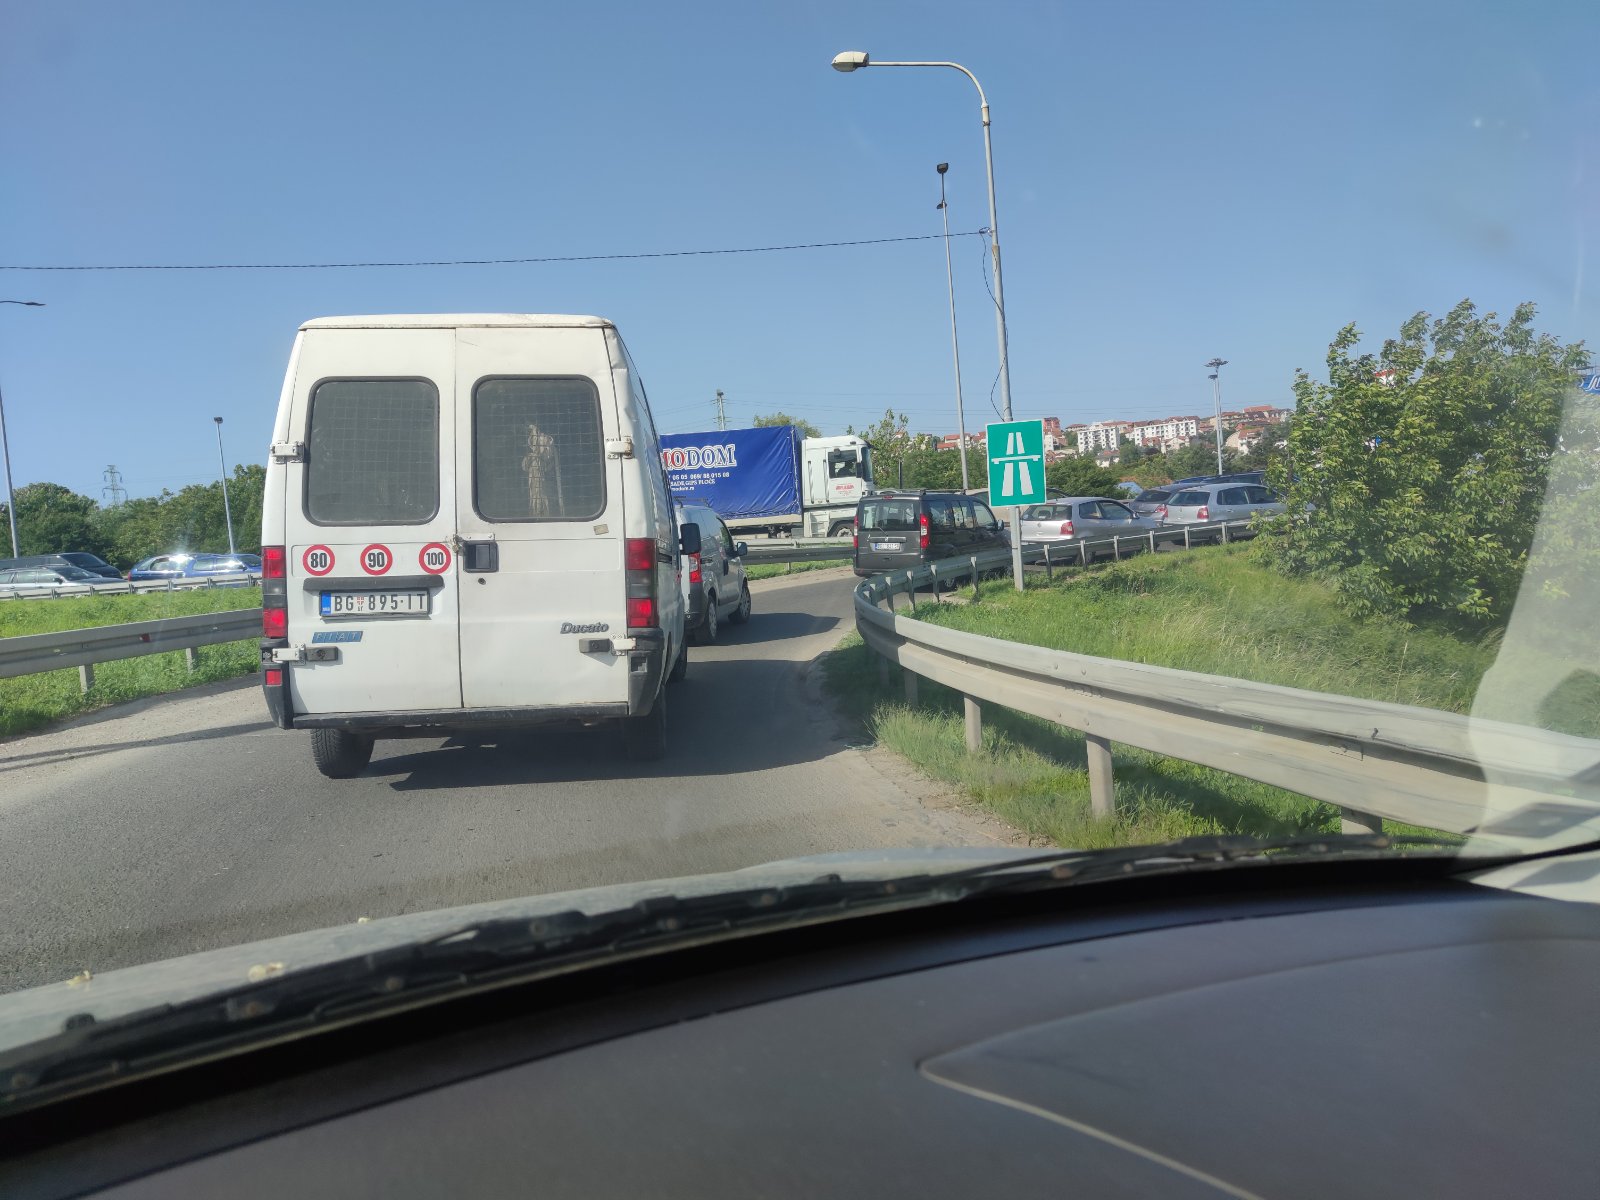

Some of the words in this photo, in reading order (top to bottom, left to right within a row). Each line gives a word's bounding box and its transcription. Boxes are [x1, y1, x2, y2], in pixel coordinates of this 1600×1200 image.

[310, 552, 328, 569] 80
[367, 551, 386, 568] 90
[425, 551, 444, 566] 100
[334, 595, 354, 612] BG
[560, 621, 610, 635] Ducato
[316, 632, 357, 641] FIAT
